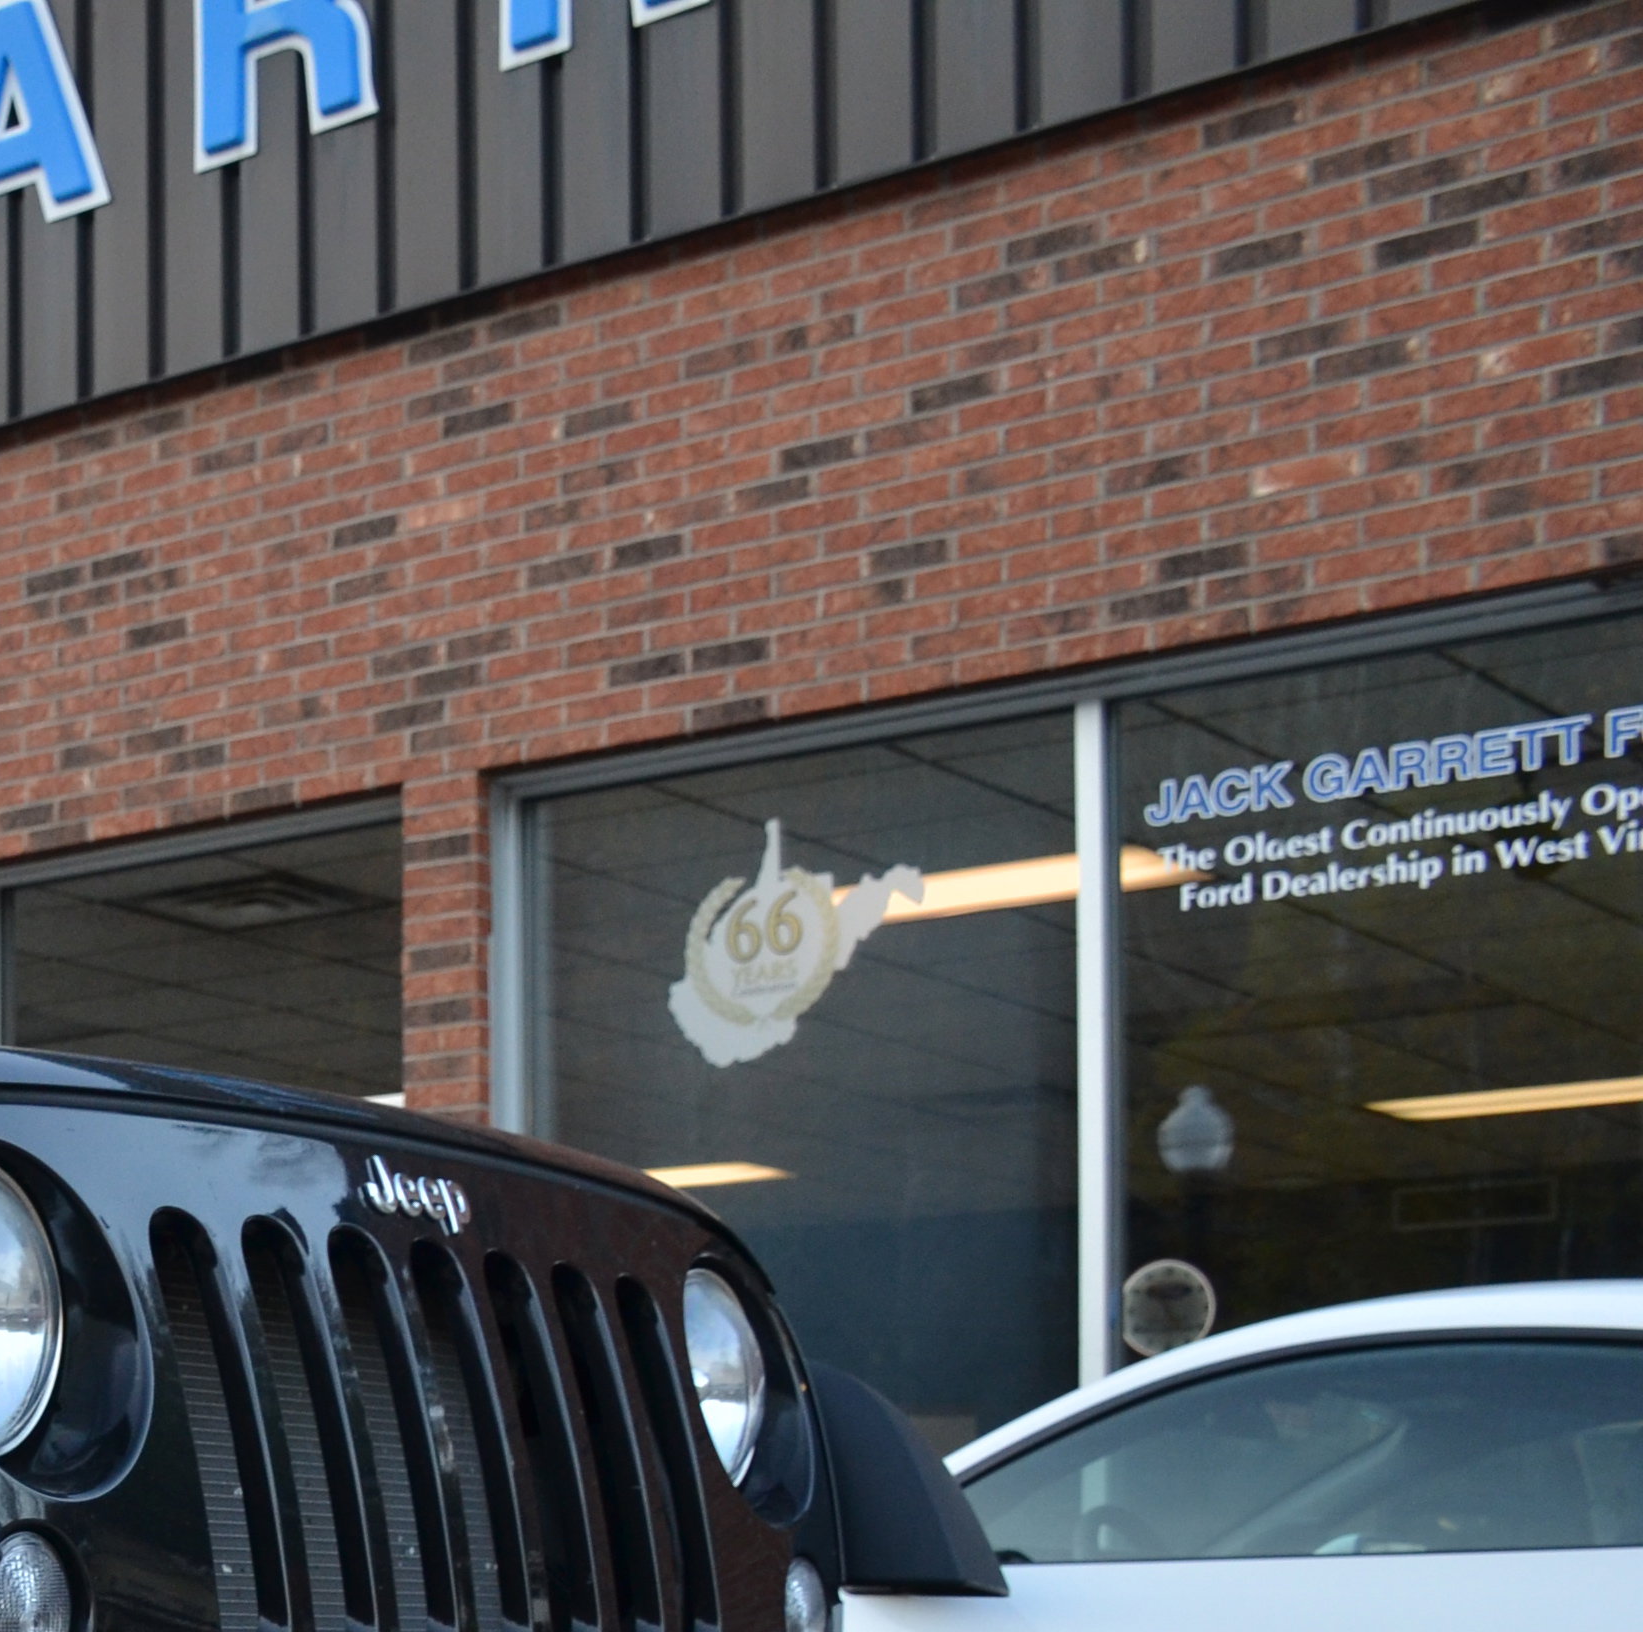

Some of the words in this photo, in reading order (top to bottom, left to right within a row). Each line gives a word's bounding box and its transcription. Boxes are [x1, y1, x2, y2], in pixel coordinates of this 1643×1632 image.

[1143, 760, 1295, 827] JACK
[1302, 714, 1593, 803] GARRETT
[1603, 703, 1643, 759] F
[1157, 842, 1217, 873] The
[1340, 788, 1573, 851] Continuously
[1178, 872, 1254, 912] Ford
[1261, 849, 1444, 902] Dealership
[1451, 844, 1487, 876] in
[1495, 830, 1591, 870] West
[1596, 819, 1643, 856] Vi
[725, 888, 804, 964] 66
[357, 1154, 472, 1237] Jeep
